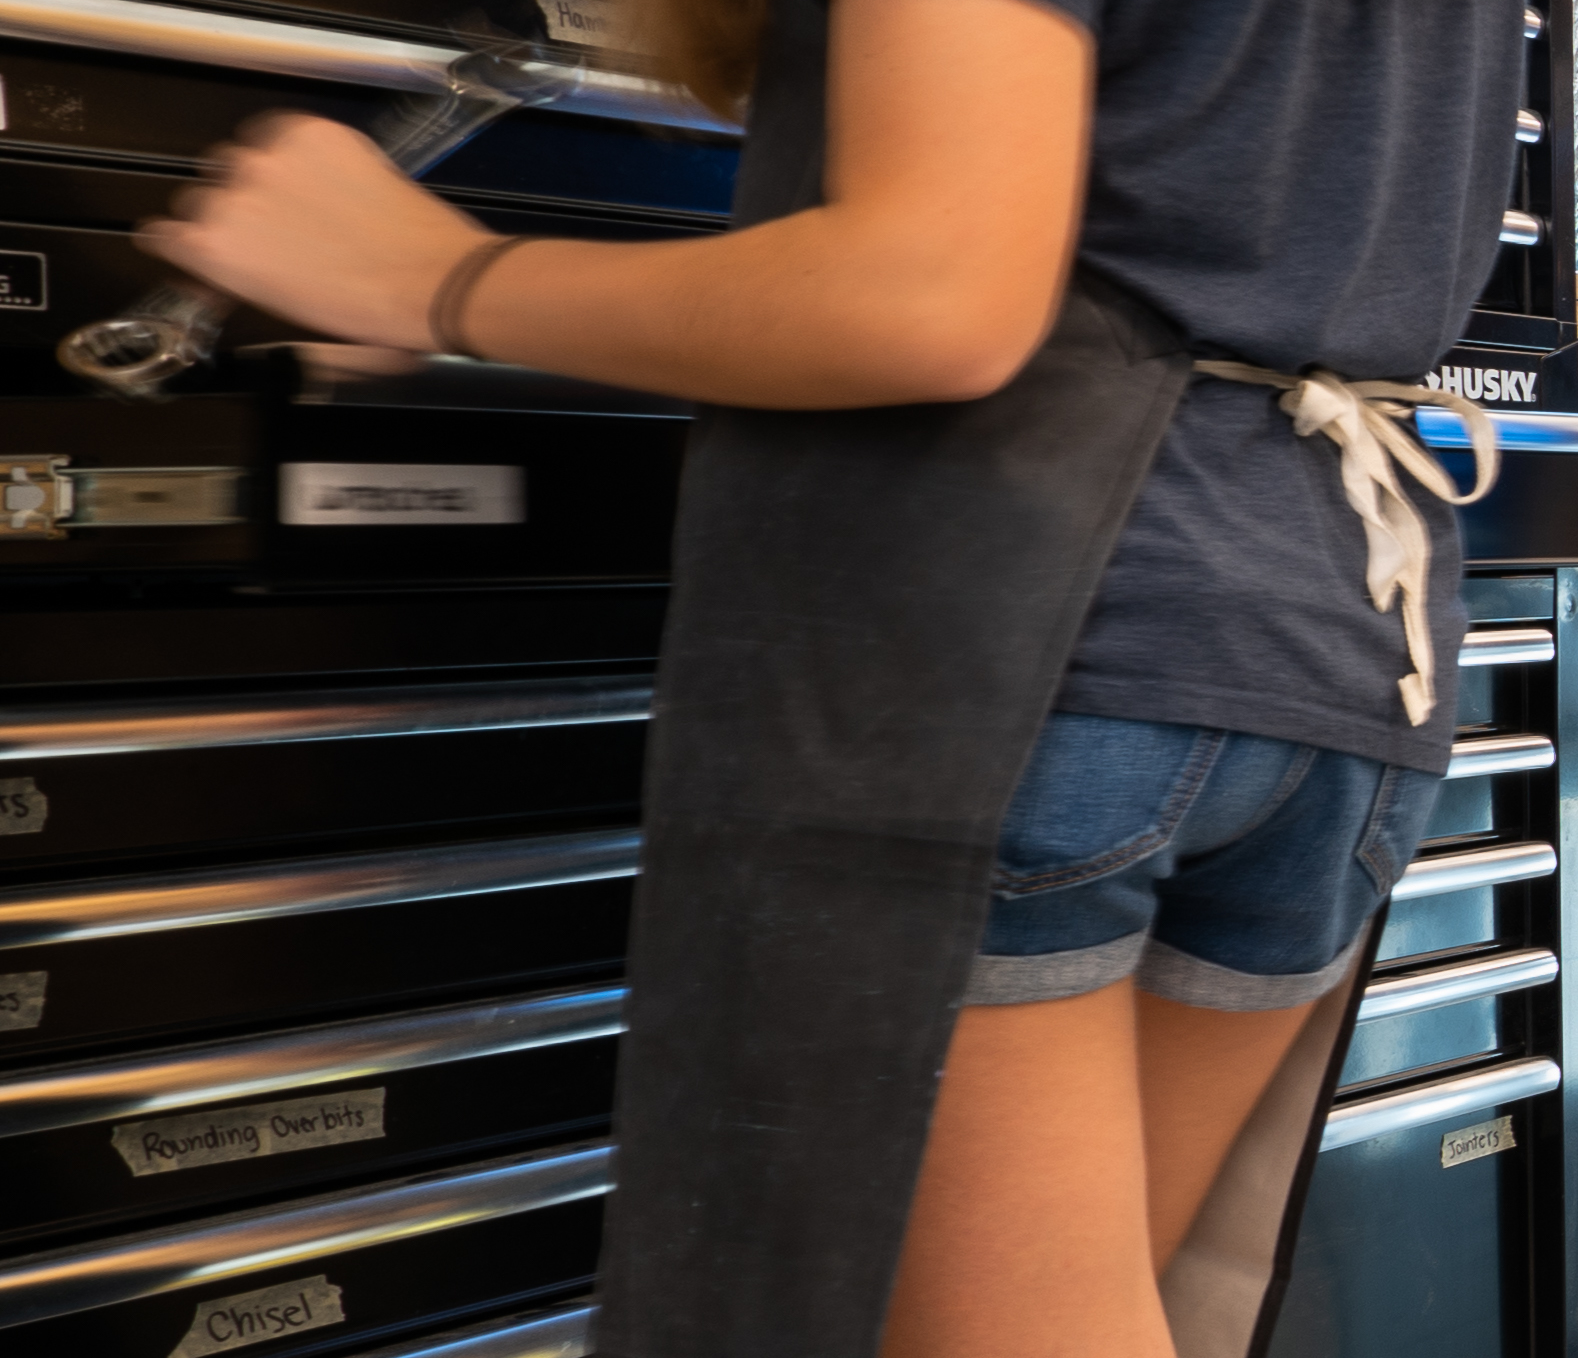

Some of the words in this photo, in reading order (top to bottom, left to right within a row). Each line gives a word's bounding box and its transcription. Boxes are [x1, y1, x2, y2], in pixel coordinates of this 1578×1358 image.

[1441, 365, 1538, 402] HUSKY
[141, 1124, 261, 1161] Rounding
[1448, 1131, 1499, 1159] Jointers
[206, 1293, 312, 1343] Chisel
